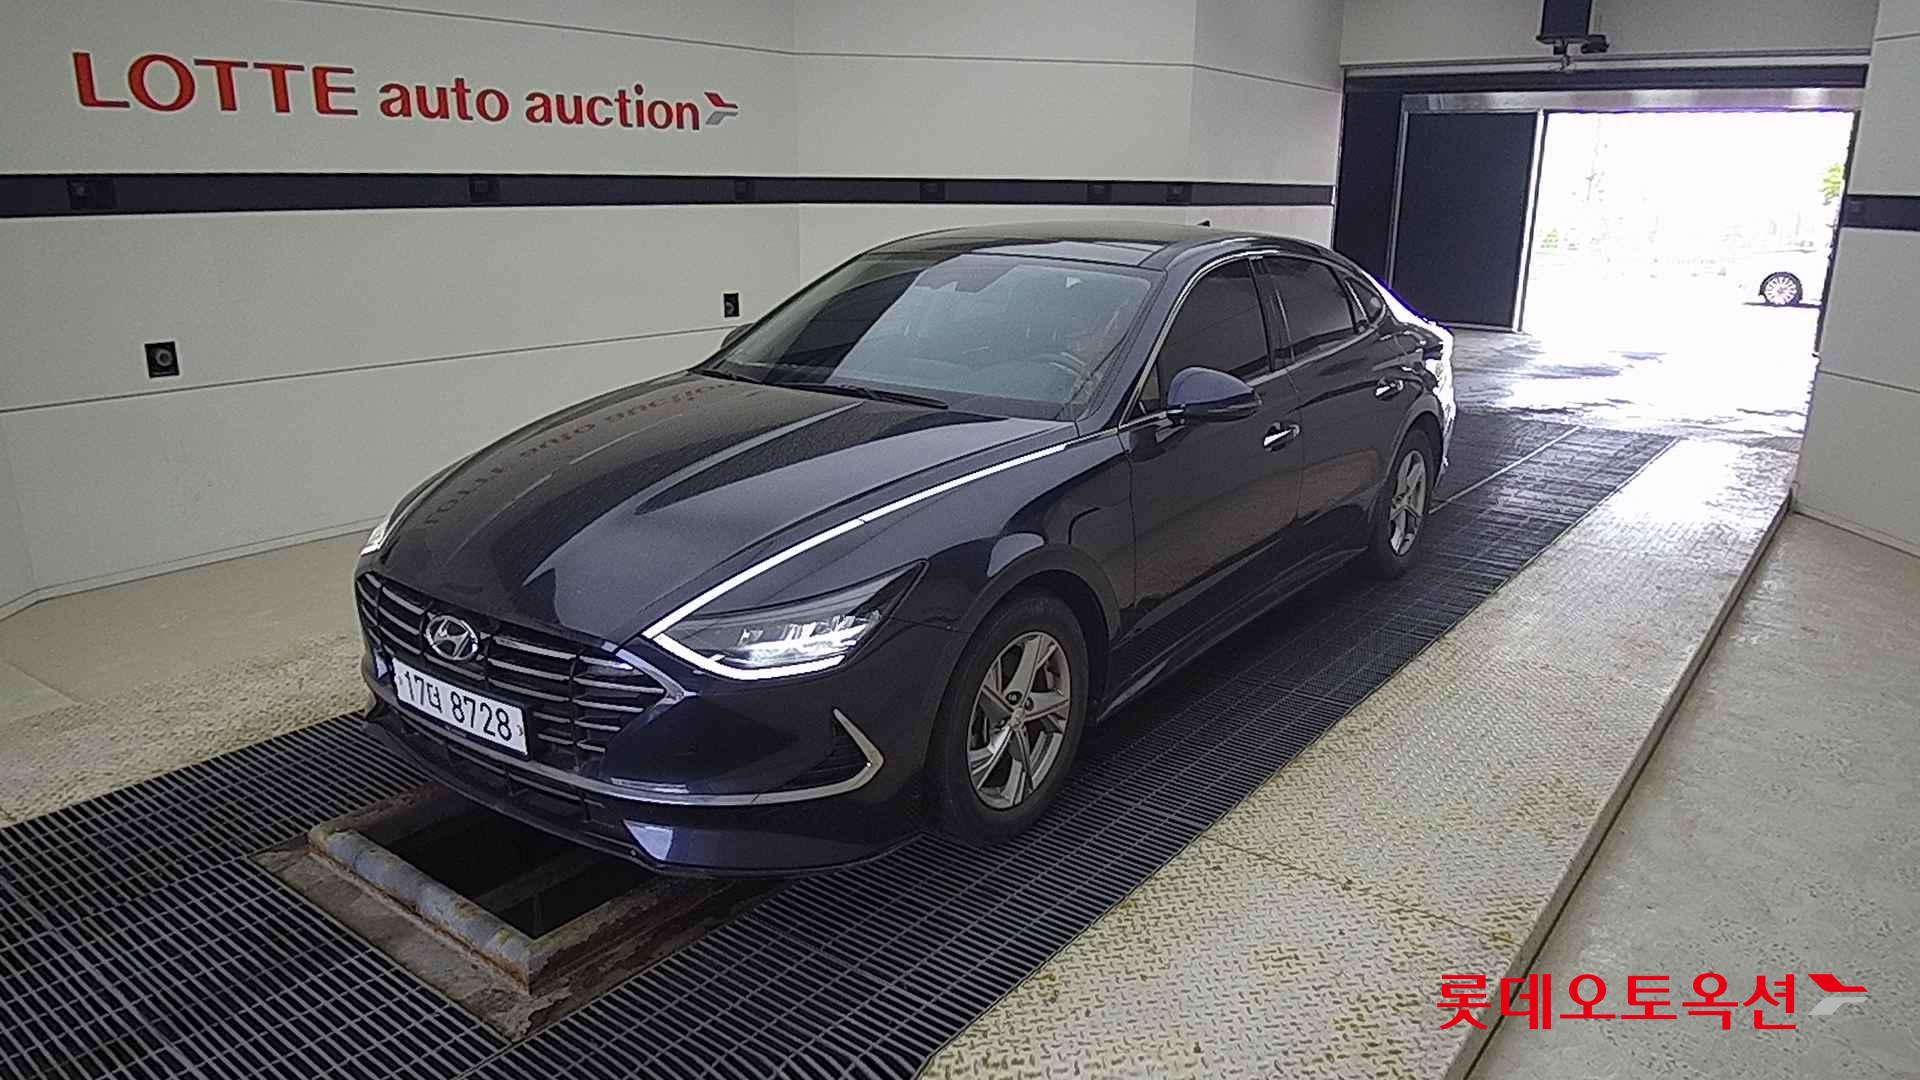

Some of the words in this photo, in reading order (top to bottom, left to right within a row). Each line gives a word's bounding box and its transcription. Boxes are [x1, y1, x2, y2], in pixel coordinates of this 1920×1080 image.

[74, 52, 358, 116] LOTTE
[380, 77, 508, 122] auto
[526, 84, 701, 130] auction
[450, 691, 512, 741] 8728
